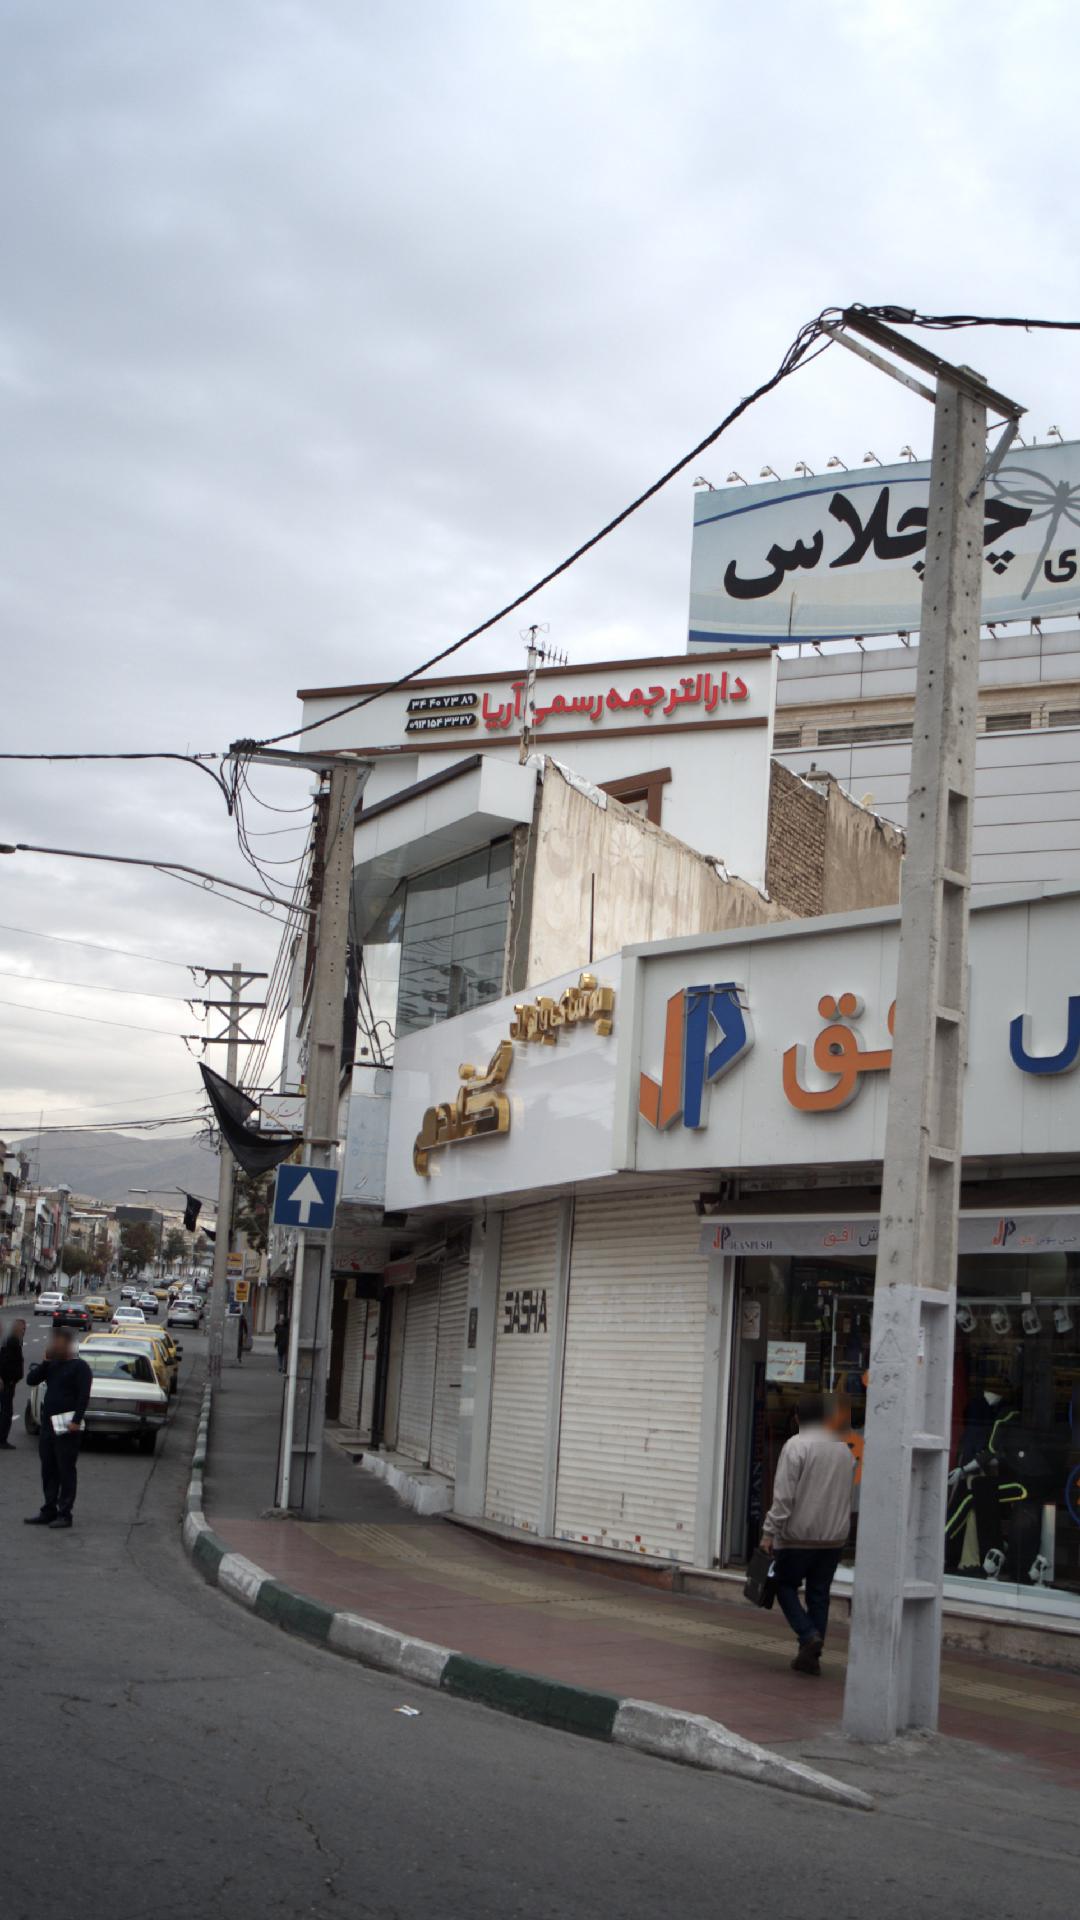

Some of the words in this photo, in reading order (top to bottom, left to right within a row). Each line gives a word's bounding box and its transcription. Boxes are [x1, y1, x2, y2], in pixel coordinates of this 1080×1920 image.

[481, 681, 525, 730] آریا
[532, 693, 603, 726] رسمی
[606, 671, 748, 716] دارالترجمه
[823, 1224, 856, 1247] افق
[504, 1289, 547, 1333] SASHA
